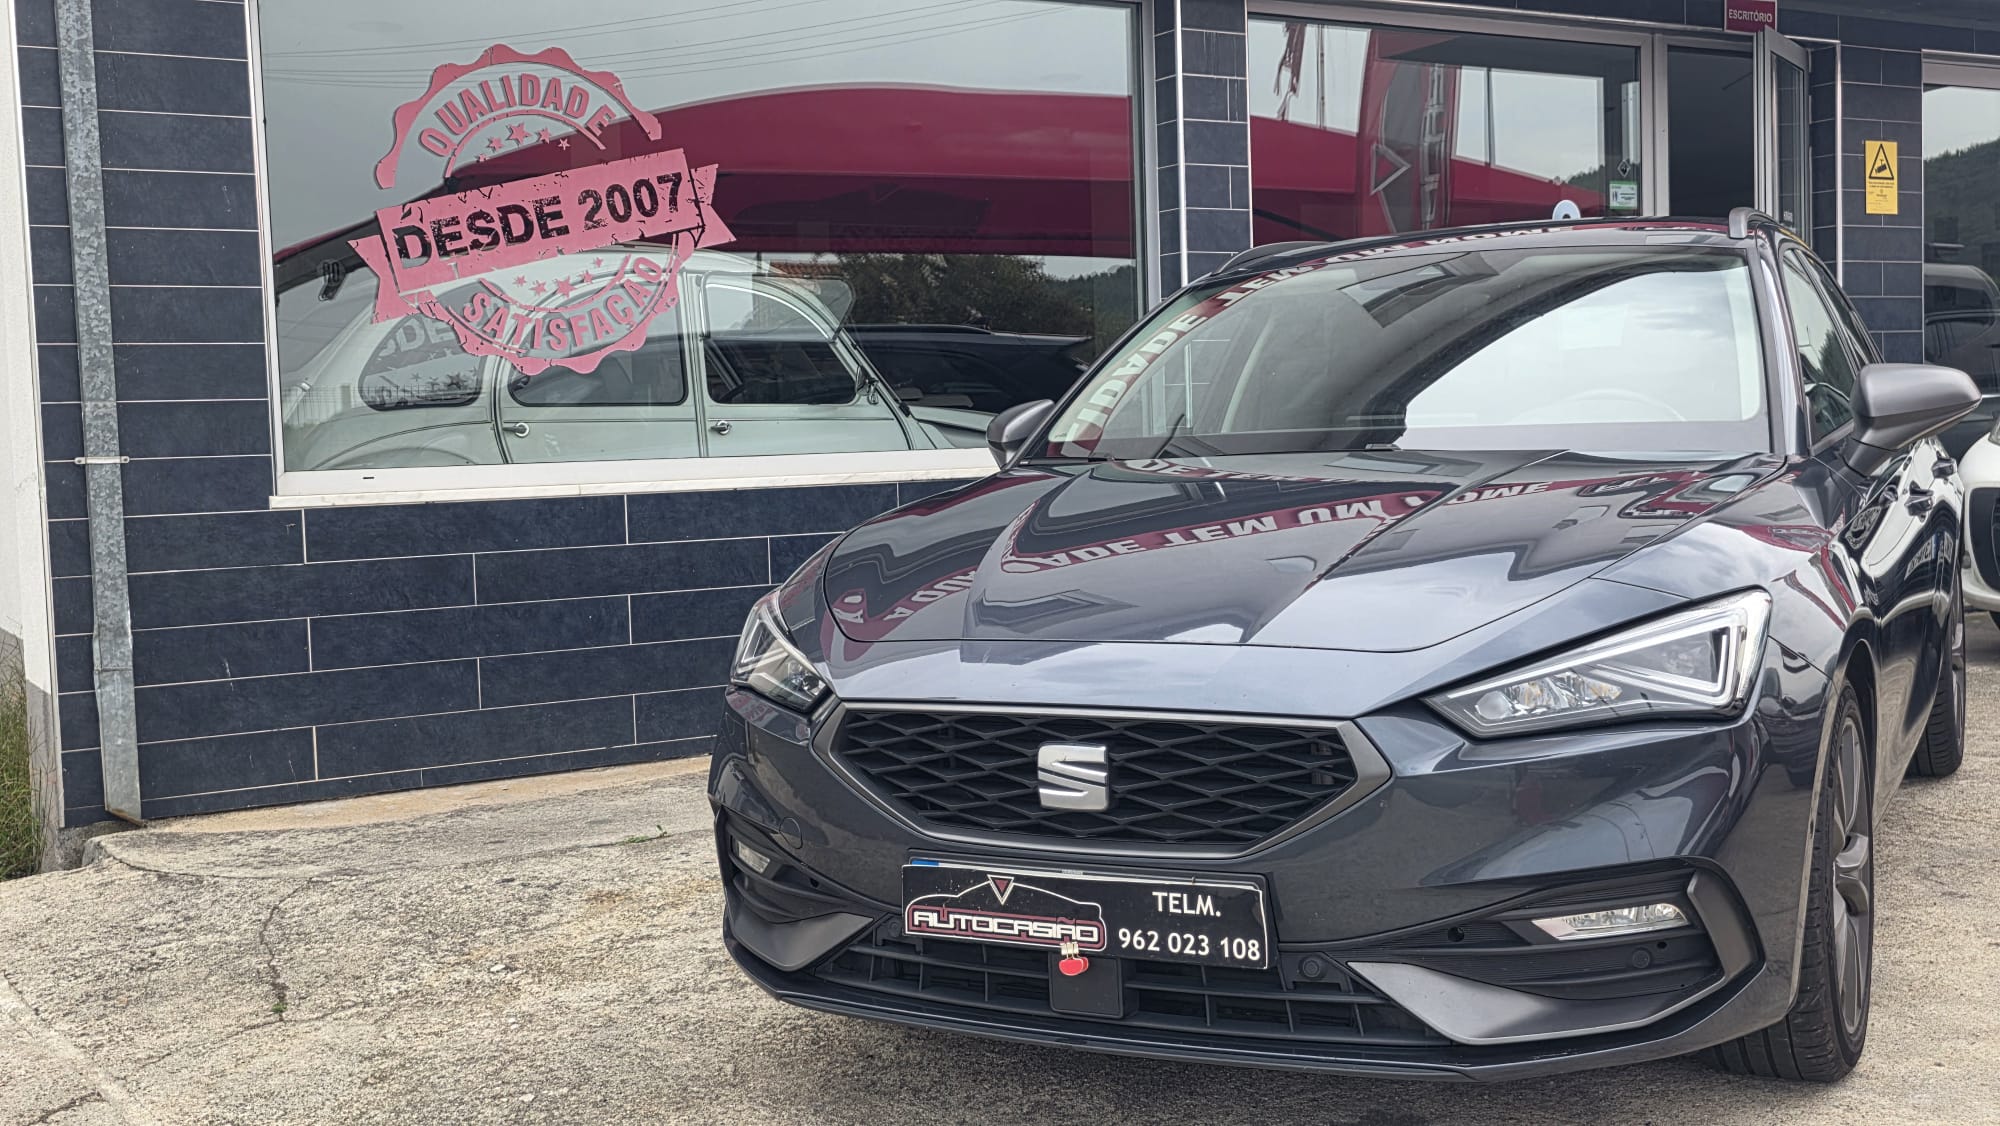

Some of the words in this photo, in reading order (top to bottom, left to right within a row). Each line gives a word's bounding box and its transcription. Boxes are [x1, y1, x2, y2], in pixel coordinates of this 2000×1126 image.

[1728, 9, 1773, 23] ESCRITÓRIO
[418, 73, 617, 157] QUALIDADE
[392, 195, 570, 269] DESDE
[578, 172, 683, 231] 2007
[1151, 890, 1222, 918] TELM.
[1118, 928, 1161, 953] 962
[1167, 932, 1210, 956] 023
[1219, 937, 1261, 961] 108
